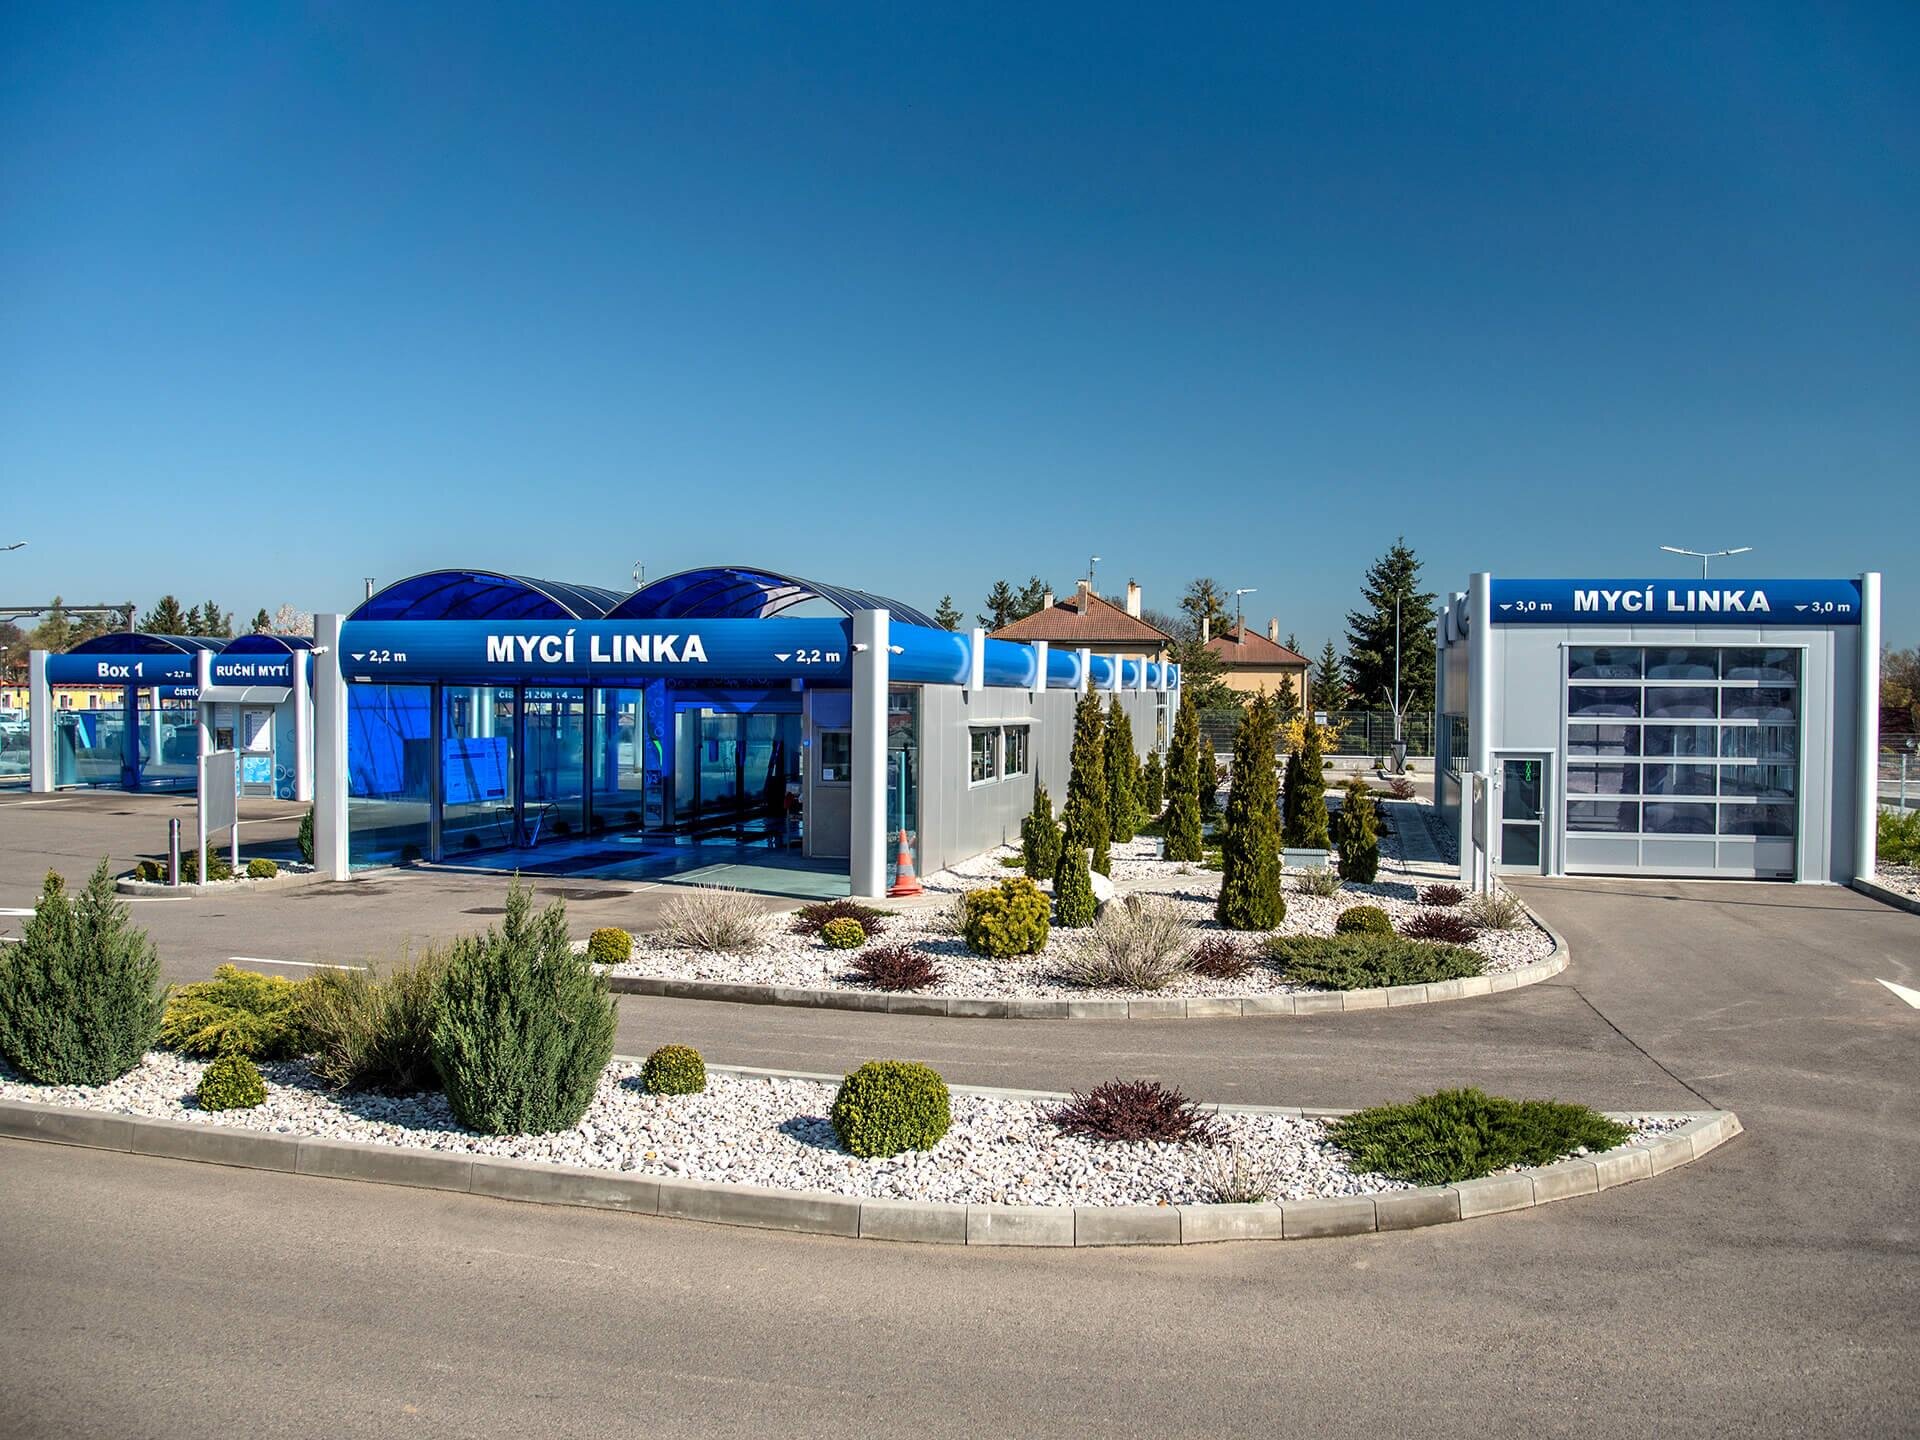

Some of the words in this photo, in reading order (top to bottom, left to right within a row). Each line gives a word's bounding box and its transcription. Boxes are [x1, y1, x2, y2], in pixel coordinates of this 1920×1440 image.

[1574, 585, 1654, 612] MYCÍ
[1667, 590, 1771, 612] LINKA
[1516, 601, 1537, 613] 3,0
[1540, 603, 1553, 611] m
[1811, 601, 1833, 613] 3,0
[1837, 604, 1851, 612] m
[486, 629, 576, 663] MYCÍ
[590, 634, 708, 663] LINKA
[369, 649, 391, 664] 2,2
[394, 652, 407, 662] m
[796, 650, 821, 664] 2,2
[825, 653, 841, 662] m
[97, 662, 130, 677] Box
[134, 662, 143, 677] 1
[216, 663, 255, 677] RUČNÍ
[258, 663, 288, 677] MYTÍ
